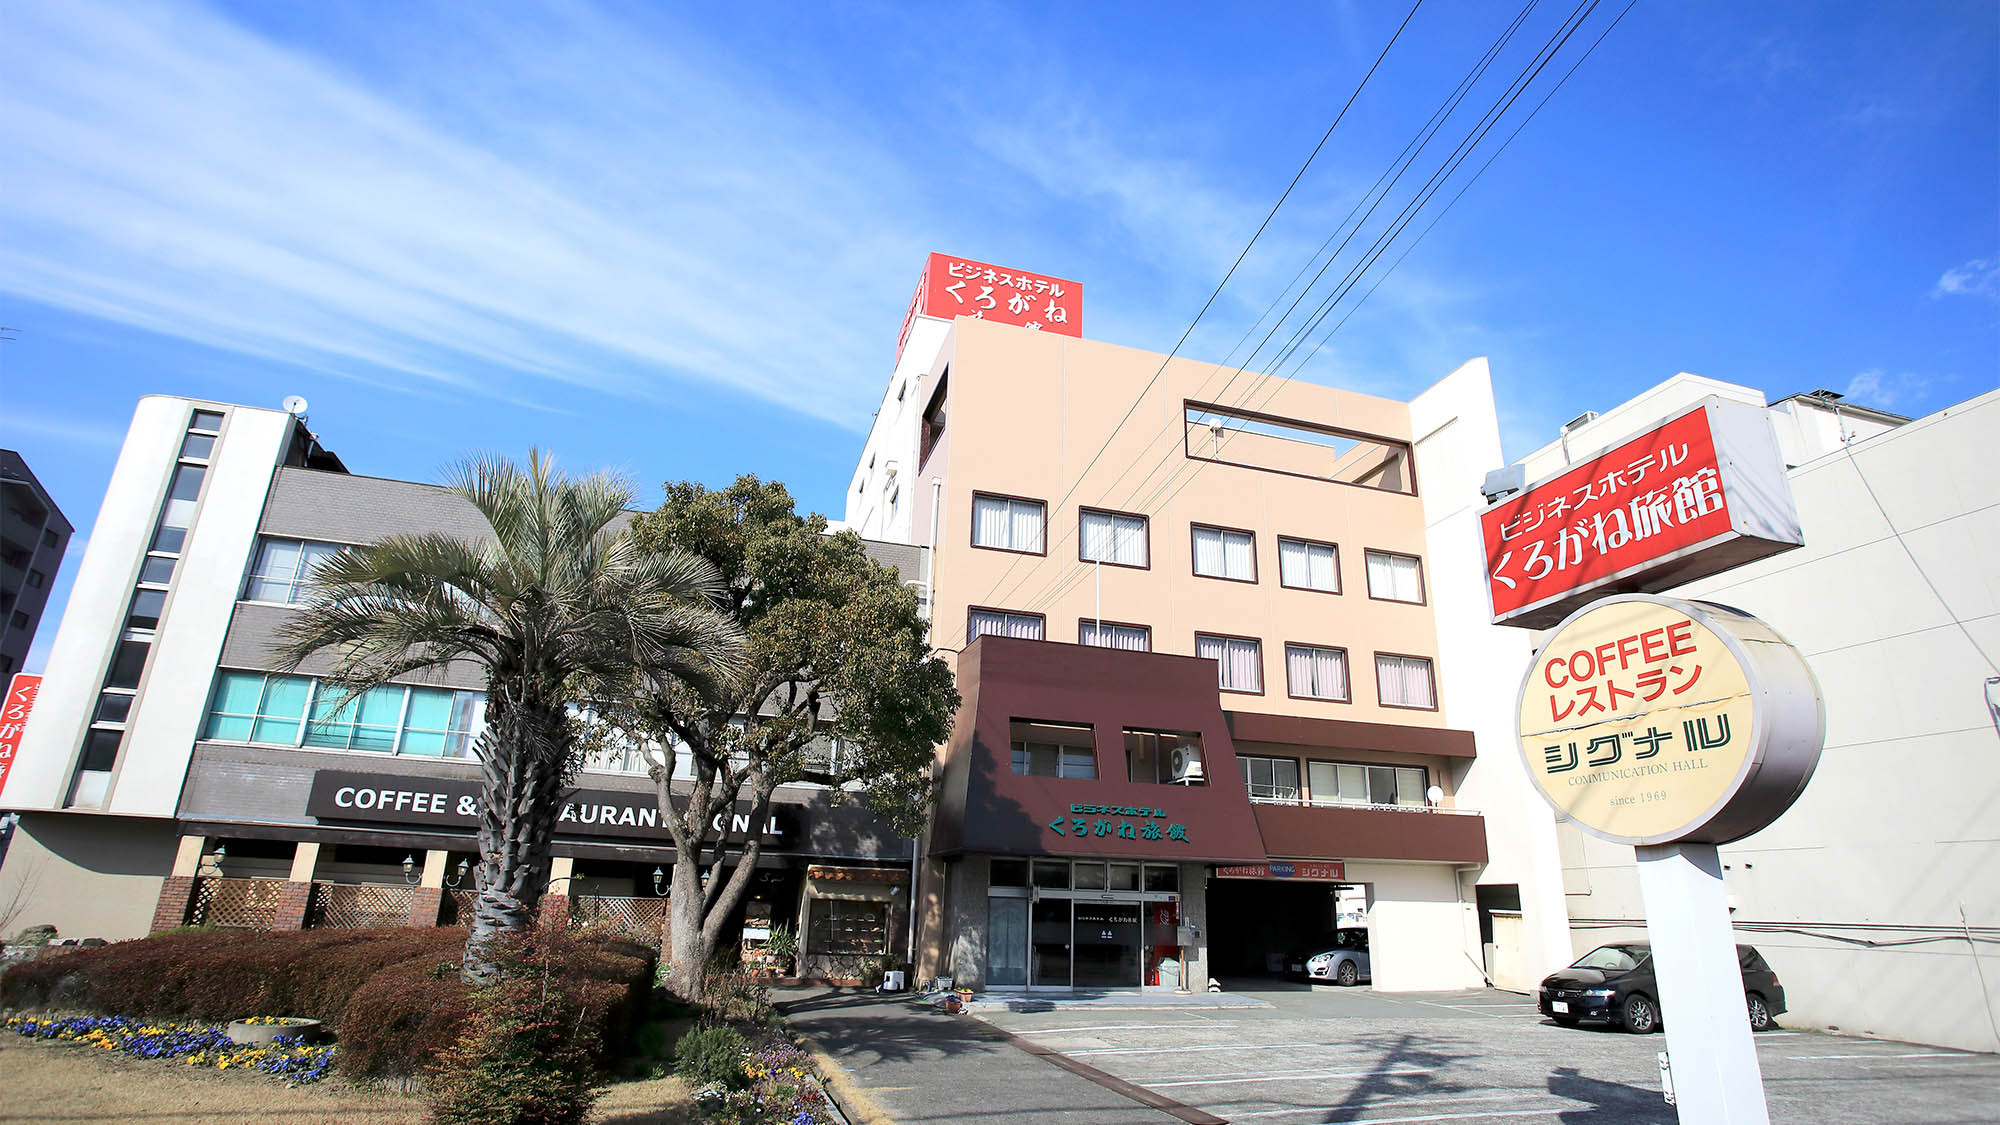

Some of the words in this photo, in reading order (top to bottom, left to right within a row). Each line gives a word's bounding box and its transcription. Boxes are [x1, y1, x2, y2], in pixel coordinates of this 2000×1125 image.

[948, 262, 1065, 298] ビジネスホテル
[945, 280, 1068, 324] くろがね
[1500, 442, 1689, 542] ビジネスホテル
[1492, 467, 1725, 590] くろがね旅館
[1544, 620, 1698, 689] COFFEE
[1549, 664, 1703, 723] レストラン
[1544, 713, 1732, 774] シグナル
[1568, 762, 1669, 787] COMMUNICATION
[1673, 758, 1709, 771] HALL
[334, 785, 448, 816] COFFEE
[456, 794, 478, 816] &
[1070, 803, 1168, 818] ビジネスホテル
[1610, 794, 1636, 807] since
[1640, 790, 1668, 803] 1969
[1269, 864, 1296, 873] PARKING
